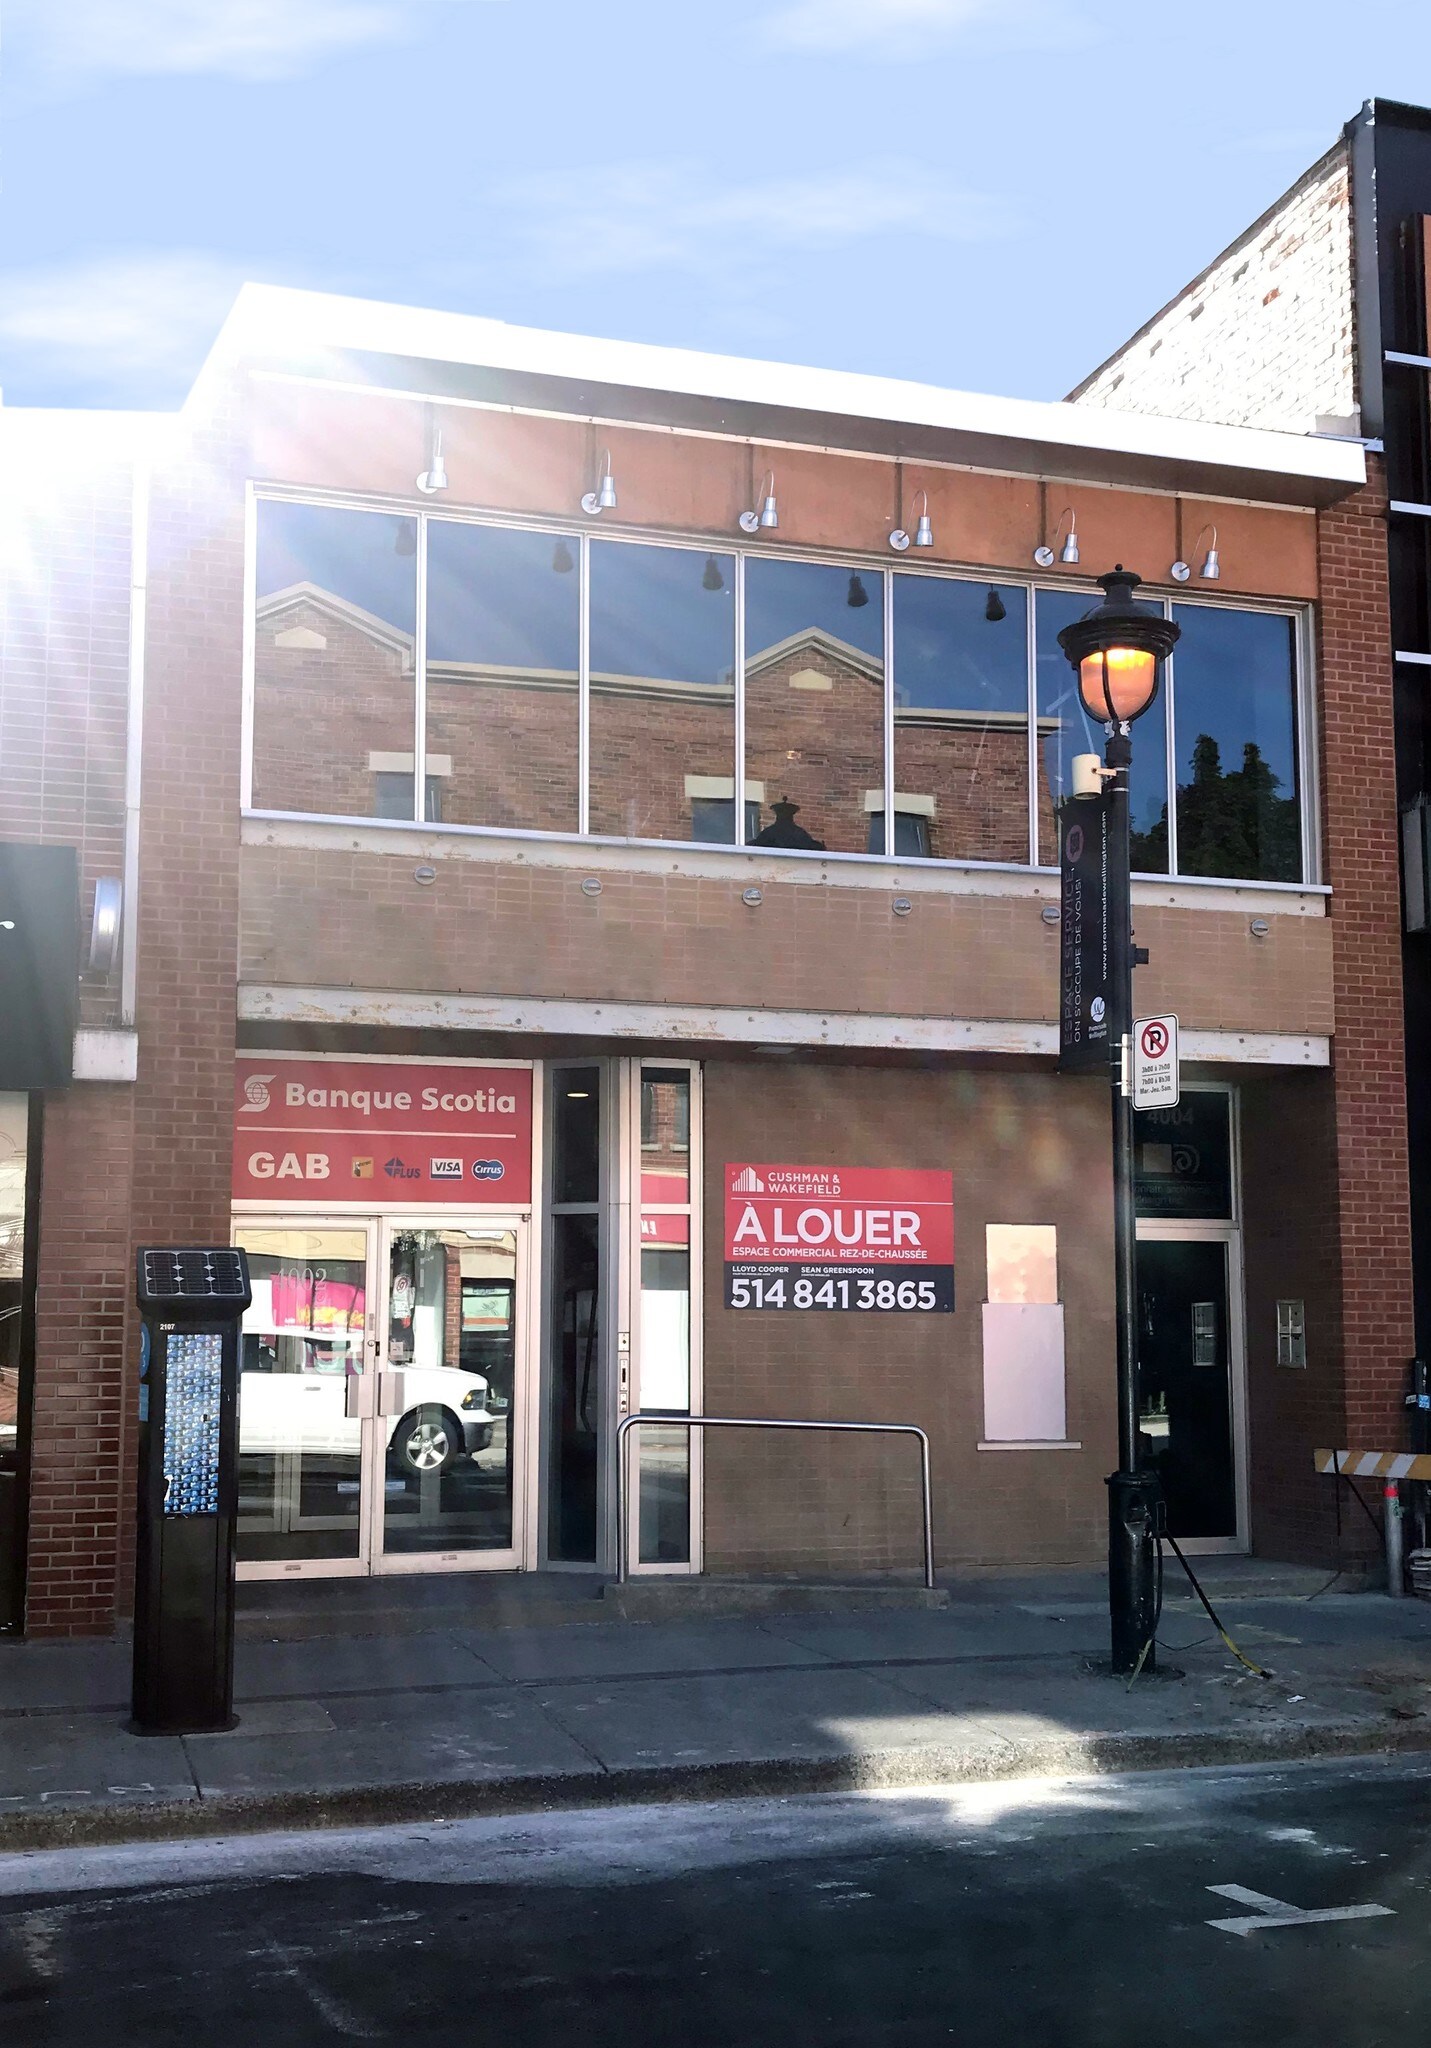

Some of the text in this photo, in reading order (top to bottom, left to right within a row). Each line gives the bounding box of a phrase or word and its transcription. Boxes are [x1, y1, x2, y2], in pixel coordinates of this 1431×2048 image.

[1074, 924, 1082, 944] DE
[1065, 966, 1074, 1046] ESPACE
[1074, 1021, 1082, 1042] ON
[285, 1082, 516, 1115] Banque Scotia
[247, 1151, 331, 1180] GAB
[435, 1162, 461, 1172] VISA
[474, 1164, 502, 1175] Cirrus
[393, 1167, 421, 1179] PLUS
[768, 1172, 841, 1184] CUSHMAN &
[768, 1183, 841, 1195] WAKEFIELD
[732, 1201, 922, 1247] À LOUER
[732, 1247, 928, 1260] ESPACE COMMERCIAL REZ-DE-CHAUSSÉE
[732, 1265, 875, 1275] LLOYD COOPER SEAN GREENSPOON
[731, 1277, 937, 1311] 514 841 3865
[160, 1323, 175, 1331] 2107
